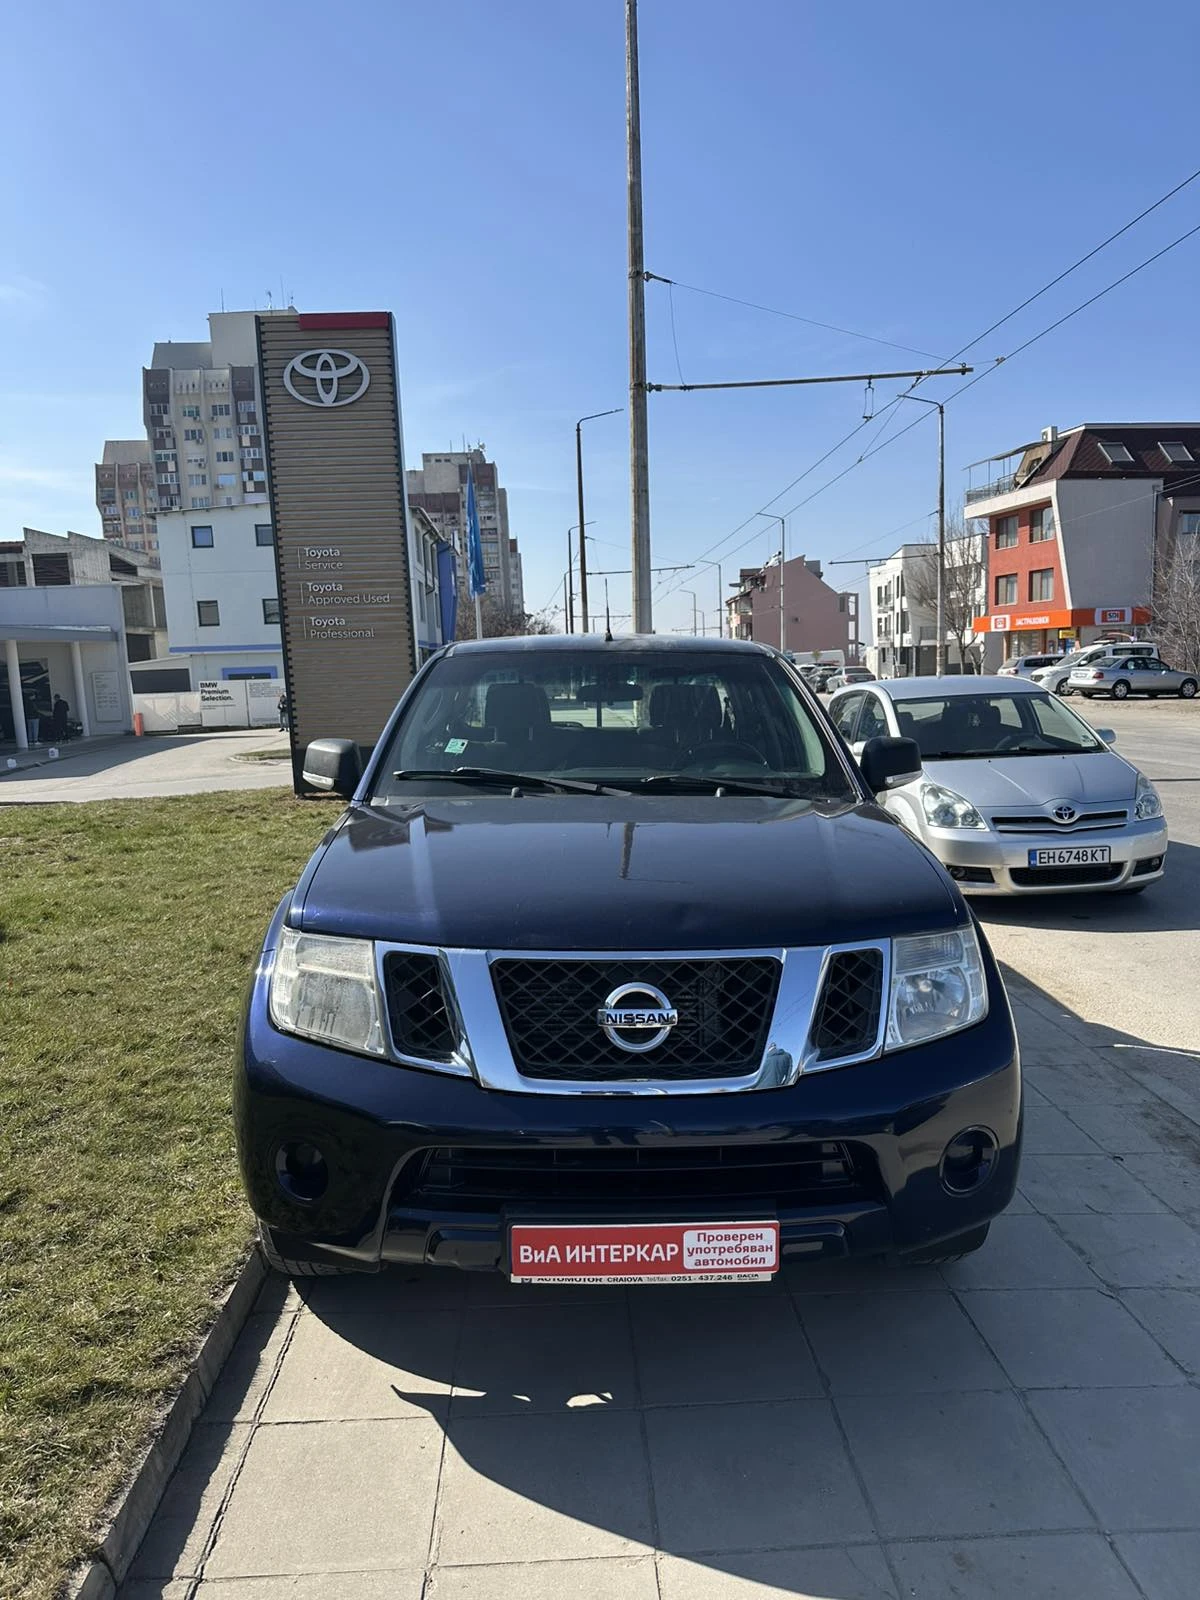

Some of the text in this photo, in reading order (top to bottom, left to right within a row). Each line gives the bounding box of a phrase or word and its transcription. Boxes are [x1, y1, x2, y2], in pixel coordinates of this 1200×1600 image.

[304, 547, 341, 559] Toyota
[304, 560, 344, 570] Service
[306, 582, 343, 594] Toyota
[307, 593, 390, 607] Approved Used
[309, 616, 346, 628] Toyota
[310, 628, 375, 639] Professional
[606, 1013, 670, 1024] NISSAN
[697, 1232, 763, 1244] Проверен
[519, 1243, 679, 1263] ВиА ИНТЕРКАР
[687, 1244, 773, 1257] употребяван
[694, 1255, 766, 1266] автомобил
